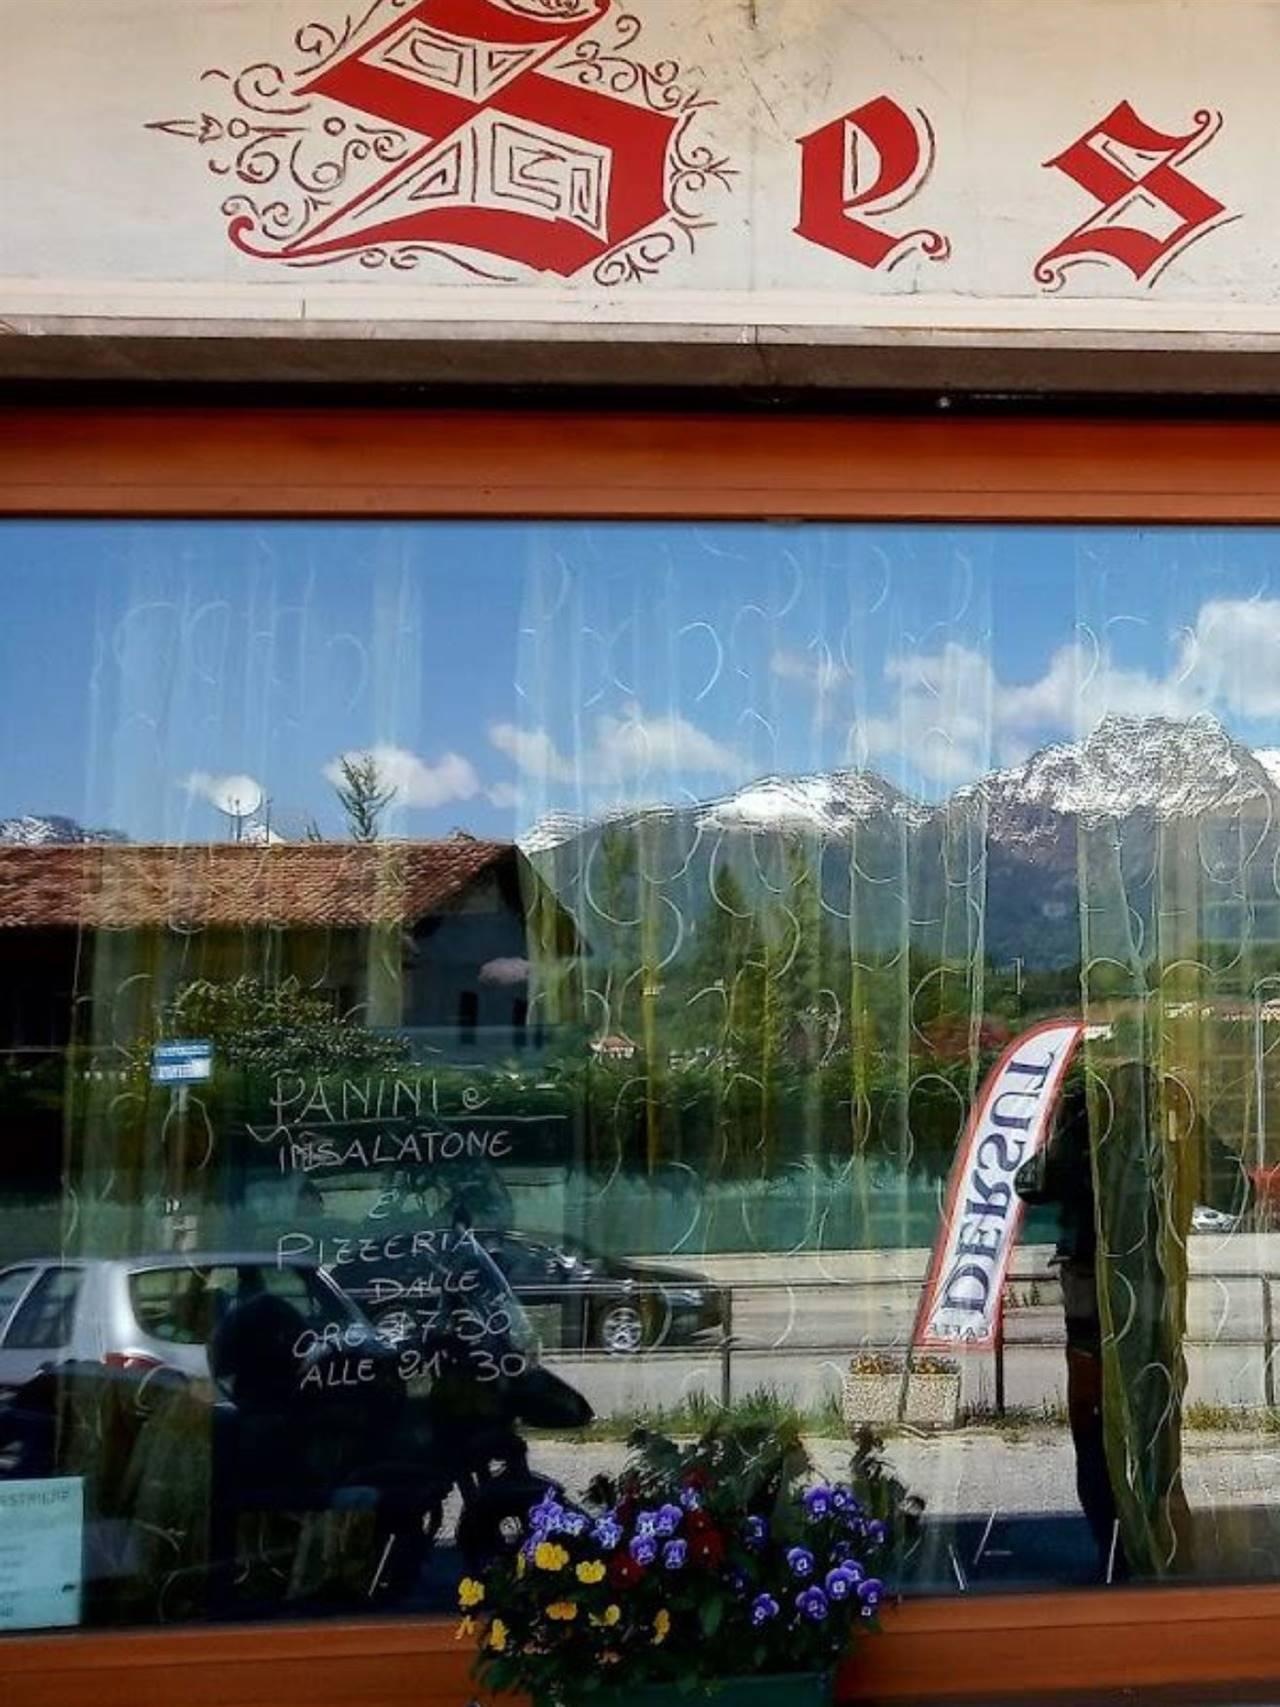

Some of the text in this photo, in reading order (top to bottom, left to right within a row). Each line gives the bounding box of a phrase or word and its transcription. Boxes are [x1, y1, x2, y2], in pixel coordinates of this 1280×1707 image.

[269, 1068, 438, 1125] PANINI
[277, 1228, 480, 1269] PIZZERIA
[368, 1269, 480, 1304] DALLE
[300, 1358, 377, 1390] ALLE
